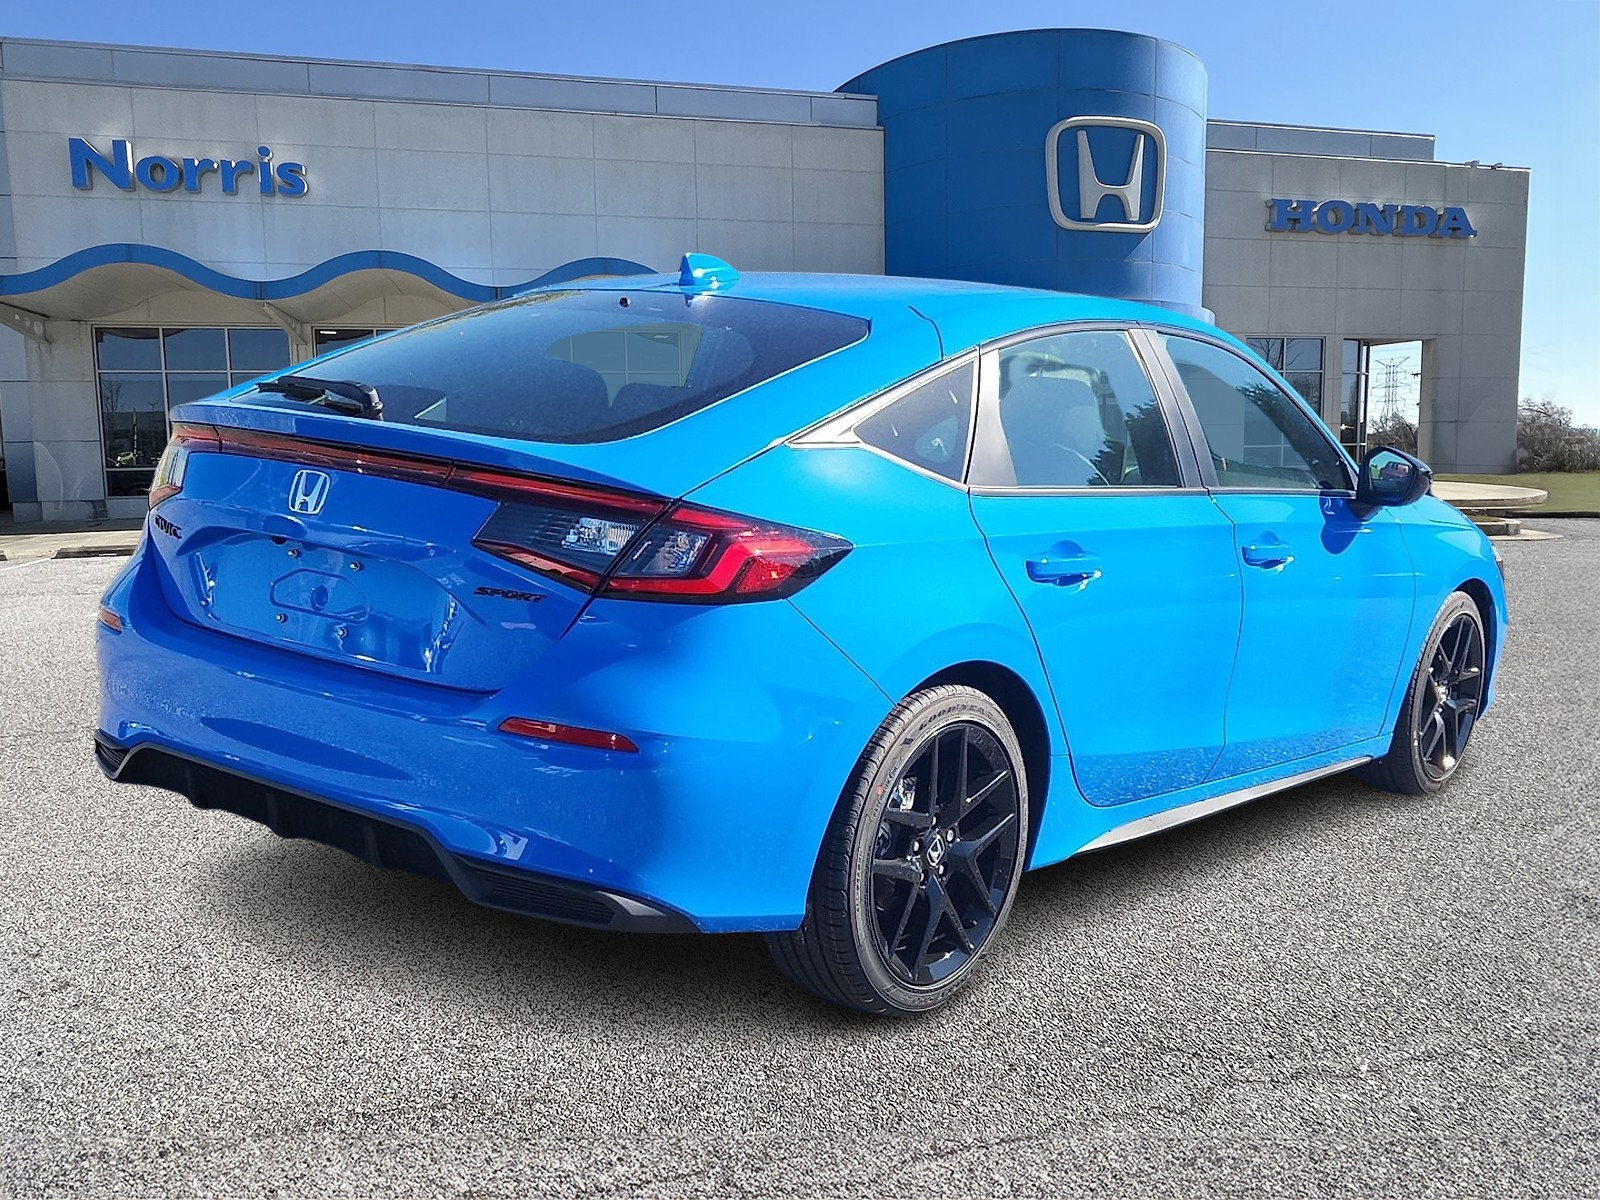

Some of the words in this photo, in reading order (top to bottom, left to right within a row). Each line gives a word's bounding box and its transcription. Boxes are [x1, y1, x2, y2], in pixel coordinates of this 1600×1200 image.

[68, 137, 308, 197] Norris
[1265, 198, 1478, 239] HONDA
[155, 514, 183, 540] CIVIC
[474, 586, 548, 603] SPORT
